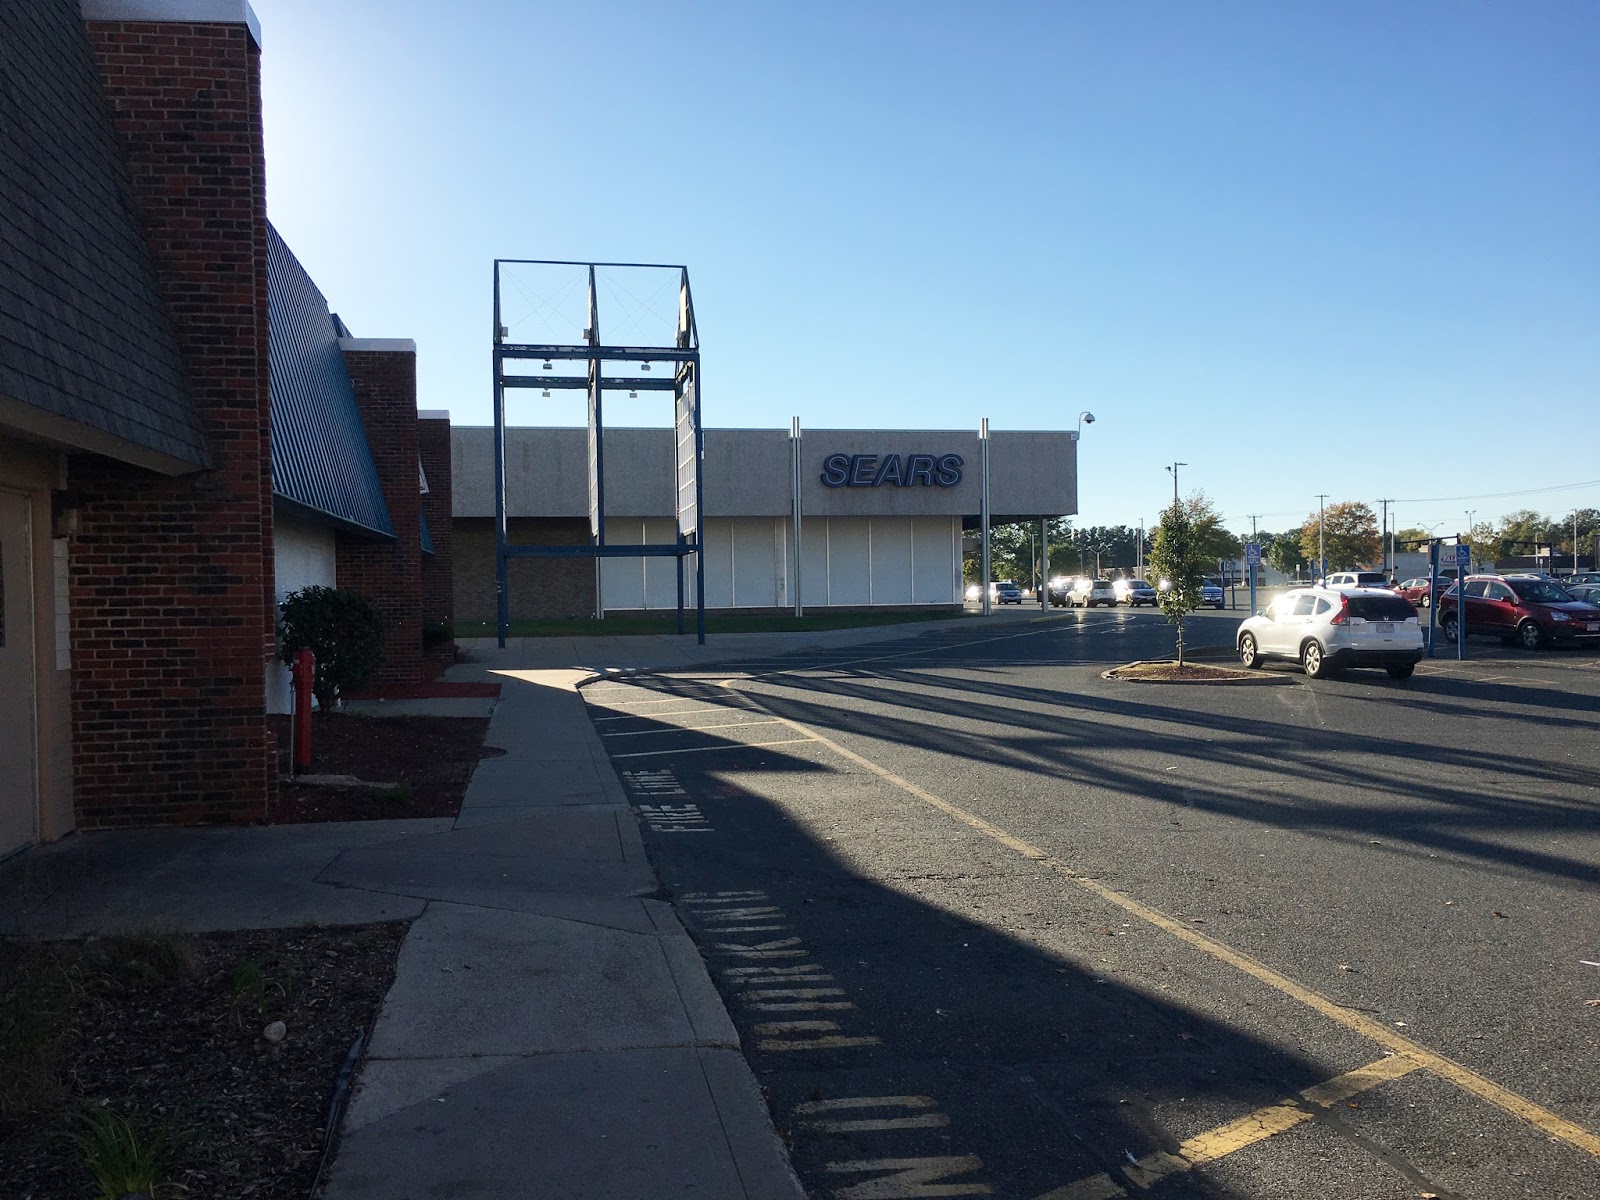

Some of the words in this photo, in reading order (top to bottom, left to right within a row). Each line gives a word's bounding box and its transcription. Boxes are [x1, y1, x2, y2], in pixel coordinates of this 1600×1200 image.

[820, 453, 965, 488] SEARS
[621, 769, 688, 796] LANE
[638, 803, 717, 833] FIRE
[680, 889, 884, 1051] PARKING
[793, 1095, 997, 1200] NO
